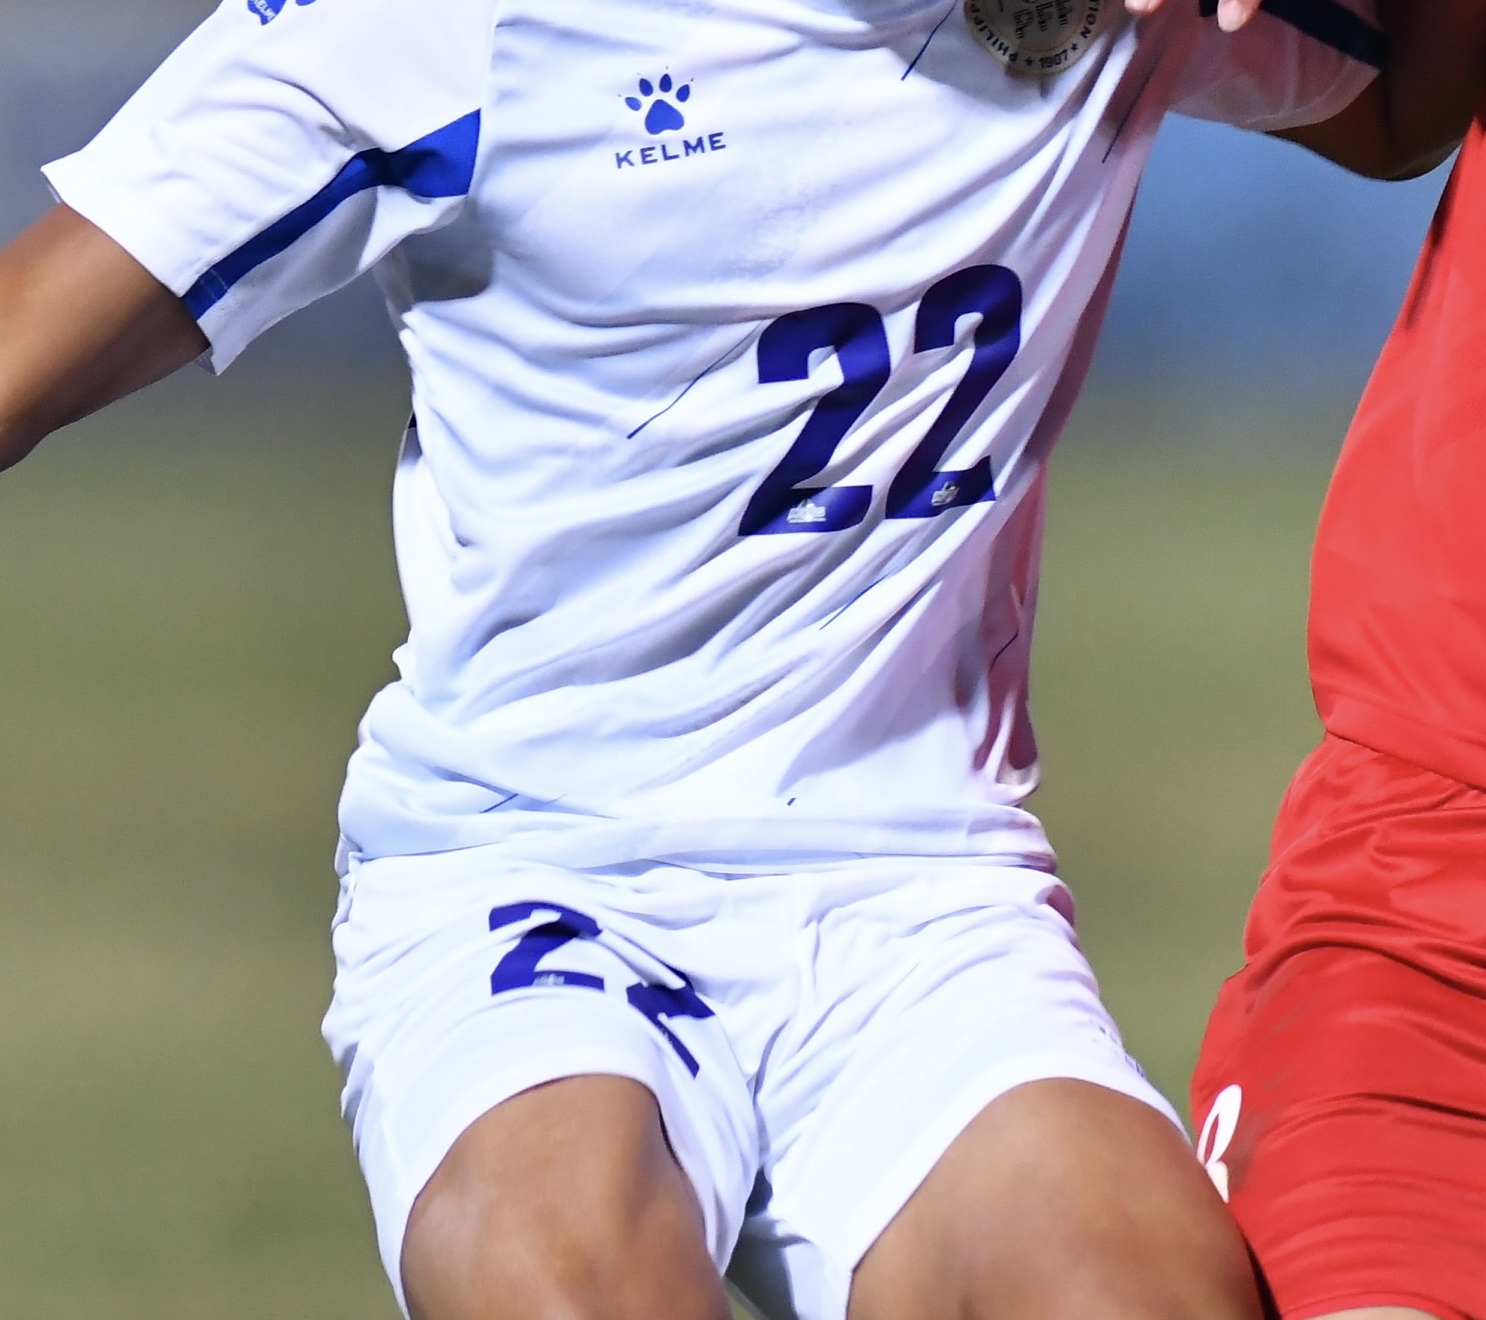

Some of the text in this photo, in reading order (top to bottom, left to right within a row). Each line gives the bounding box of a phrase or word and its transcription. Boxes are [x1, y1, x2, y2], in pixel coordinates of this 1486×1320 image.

[1039, 48, 1069, 69] 1907
[614, 131, 727, 170] KELME
[736, 263, 1024, 537] 22
